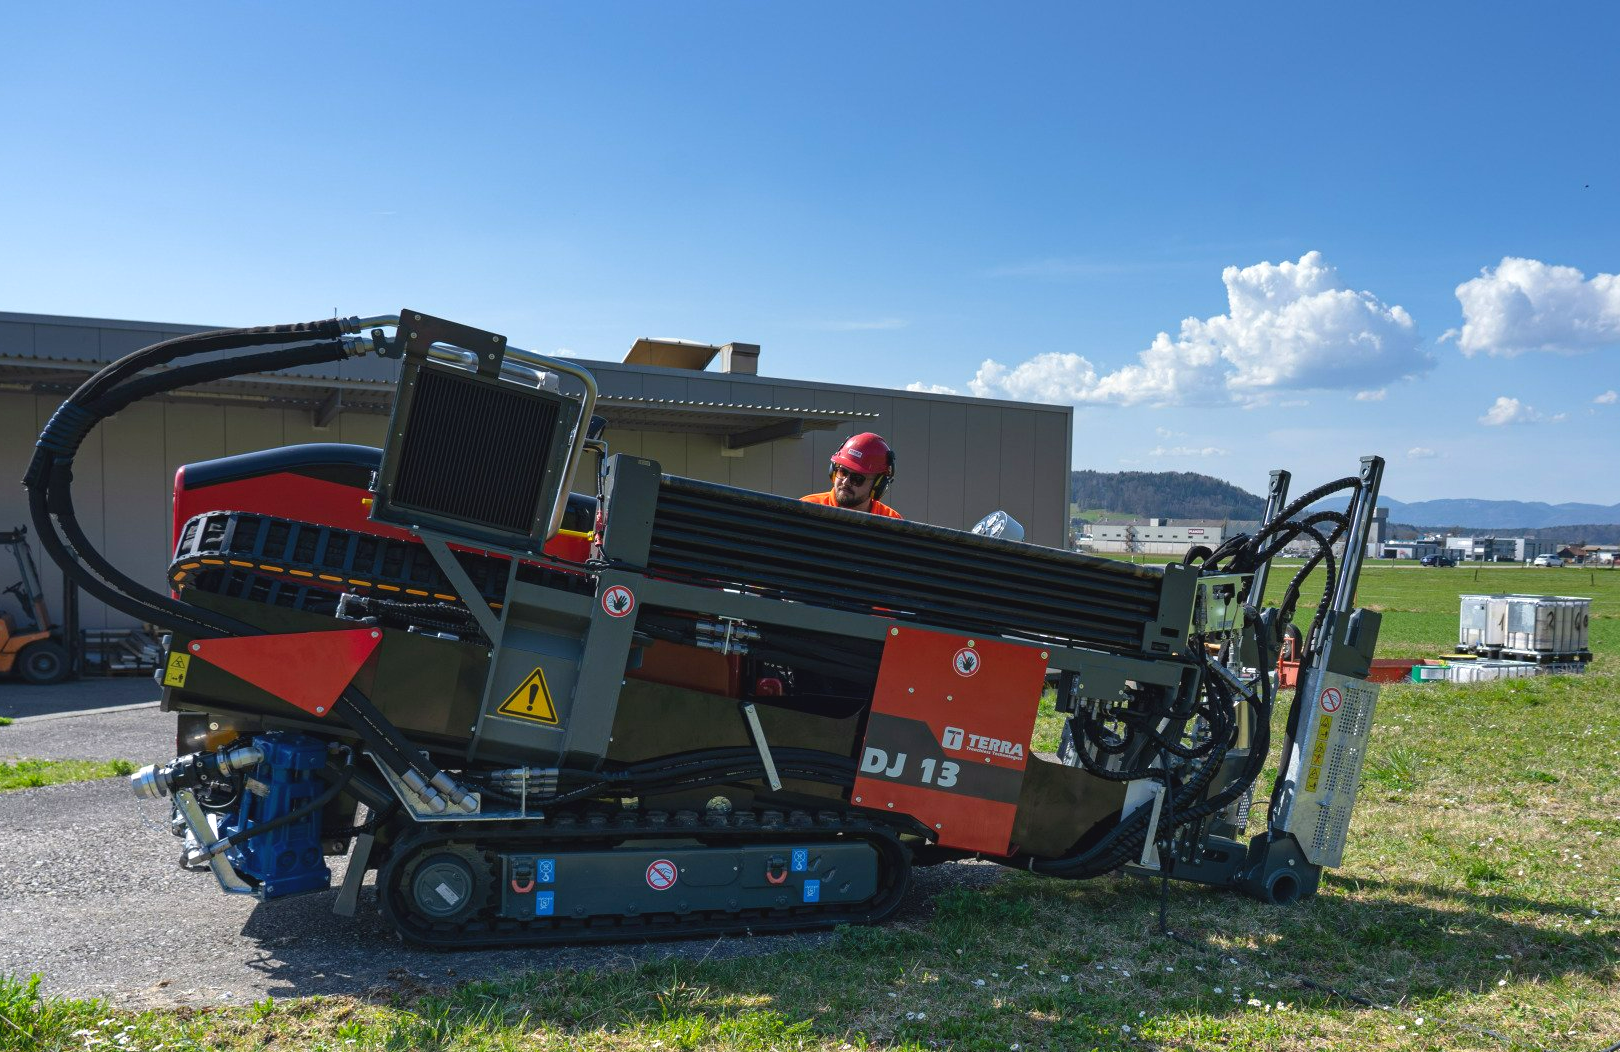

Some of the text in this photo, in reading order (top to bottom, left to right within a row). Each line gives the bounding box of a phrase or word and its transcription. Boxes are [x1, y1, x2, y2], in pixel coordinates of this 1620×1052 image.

[968, 734, 1024, 757] TERRA
[860, 746, 960, 788] DJ 13
